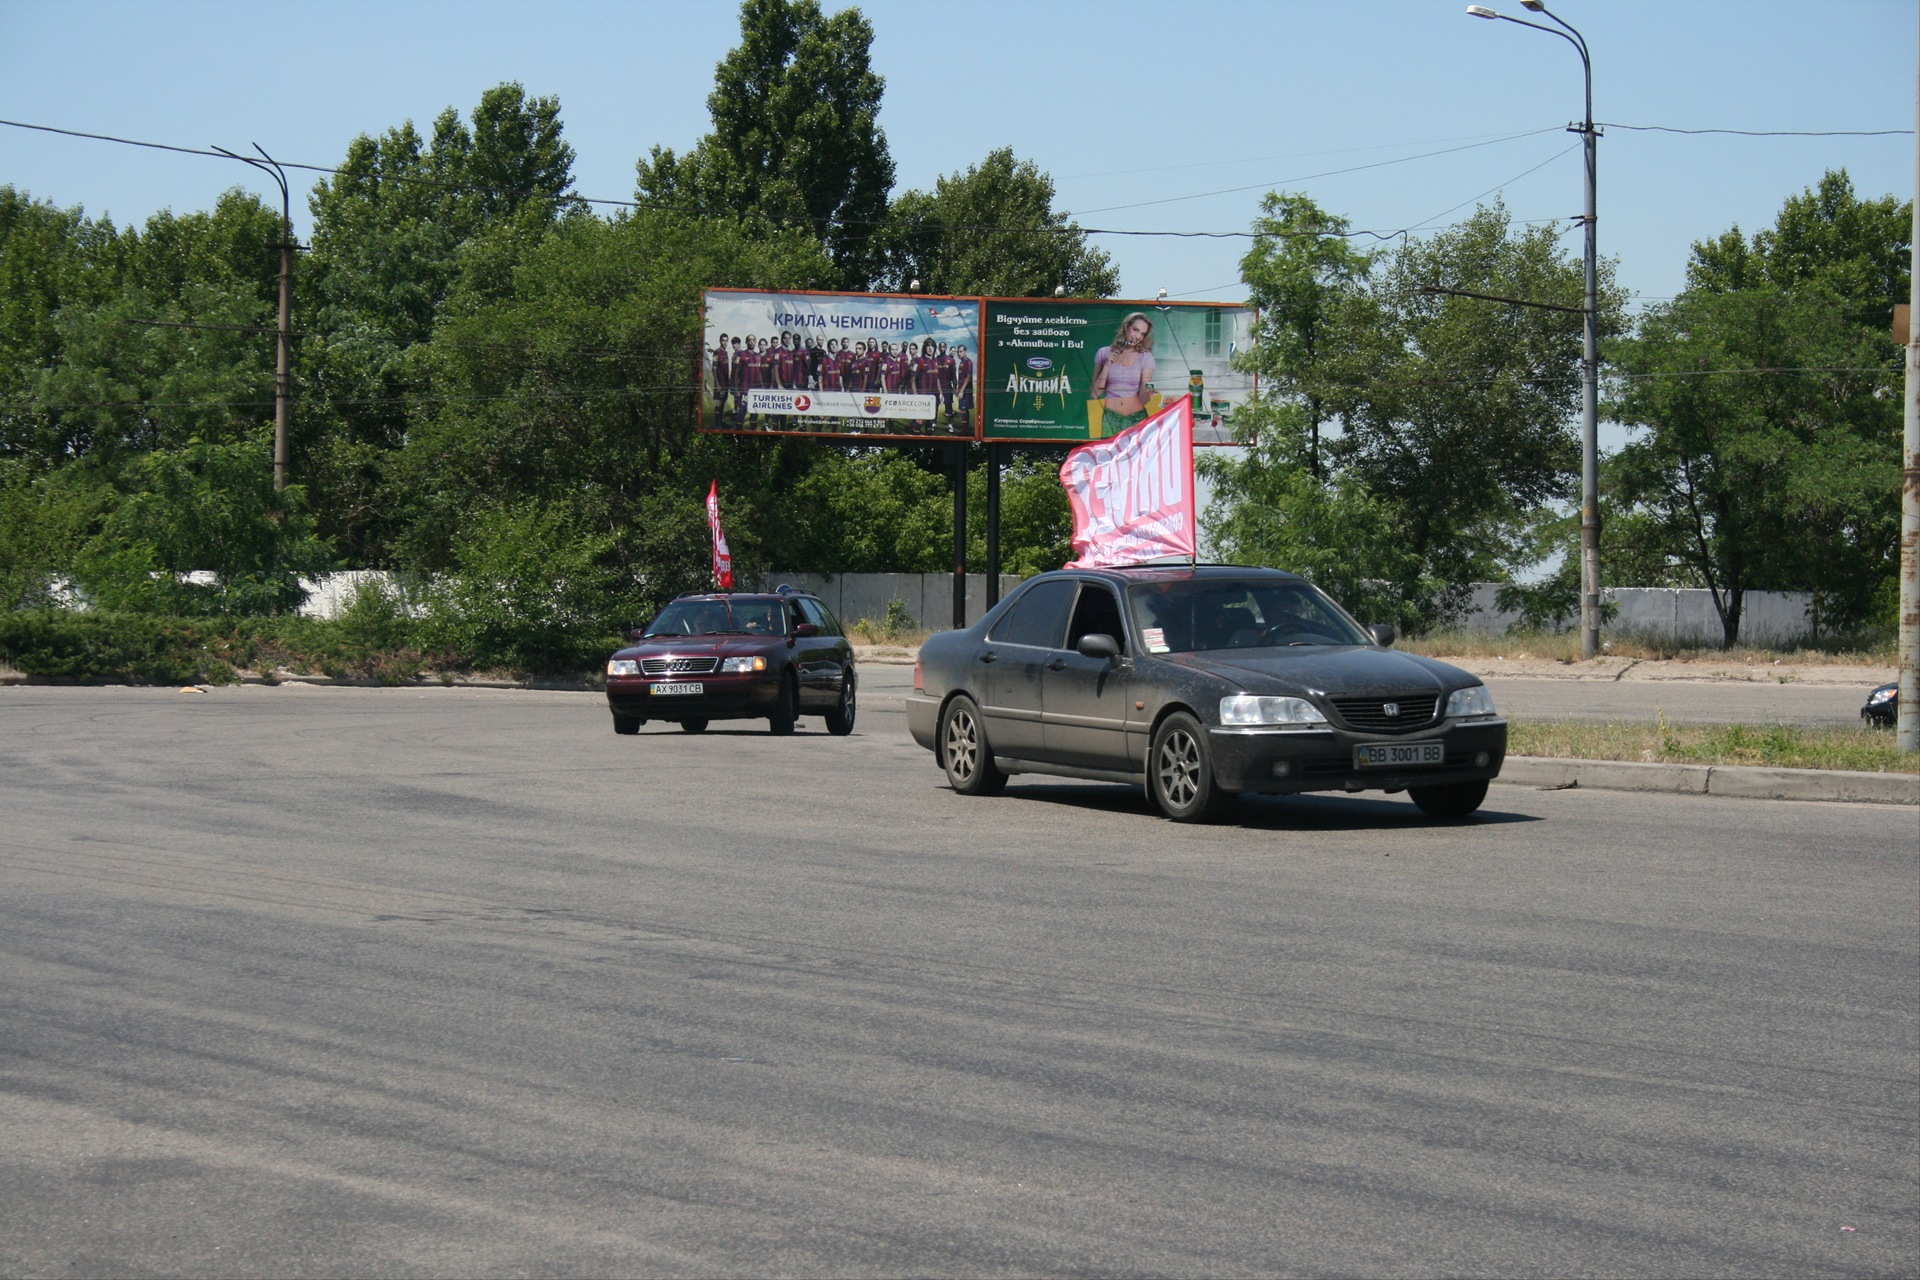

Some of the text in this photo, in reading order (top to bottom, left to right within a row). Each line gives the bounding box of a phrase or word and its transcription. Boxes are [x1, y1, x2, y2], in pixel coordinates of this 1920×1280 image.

[774, 312, 915, 330] КРИЛА ЧЕМПІОНІВ
[996, 314, 1088, 325] Відчуйте легкість
[1013, 327, 1070, 336] без зайвого
[1067, 340, 1084, 349] Ви!
[752, 394, 793, 402] TURKISH
[752, 401, 793, 410] AIRLINES
[655, 684, 702, 693] AX 9031 CB
[1369, 746, 1440, 763] BB 3001 BB
